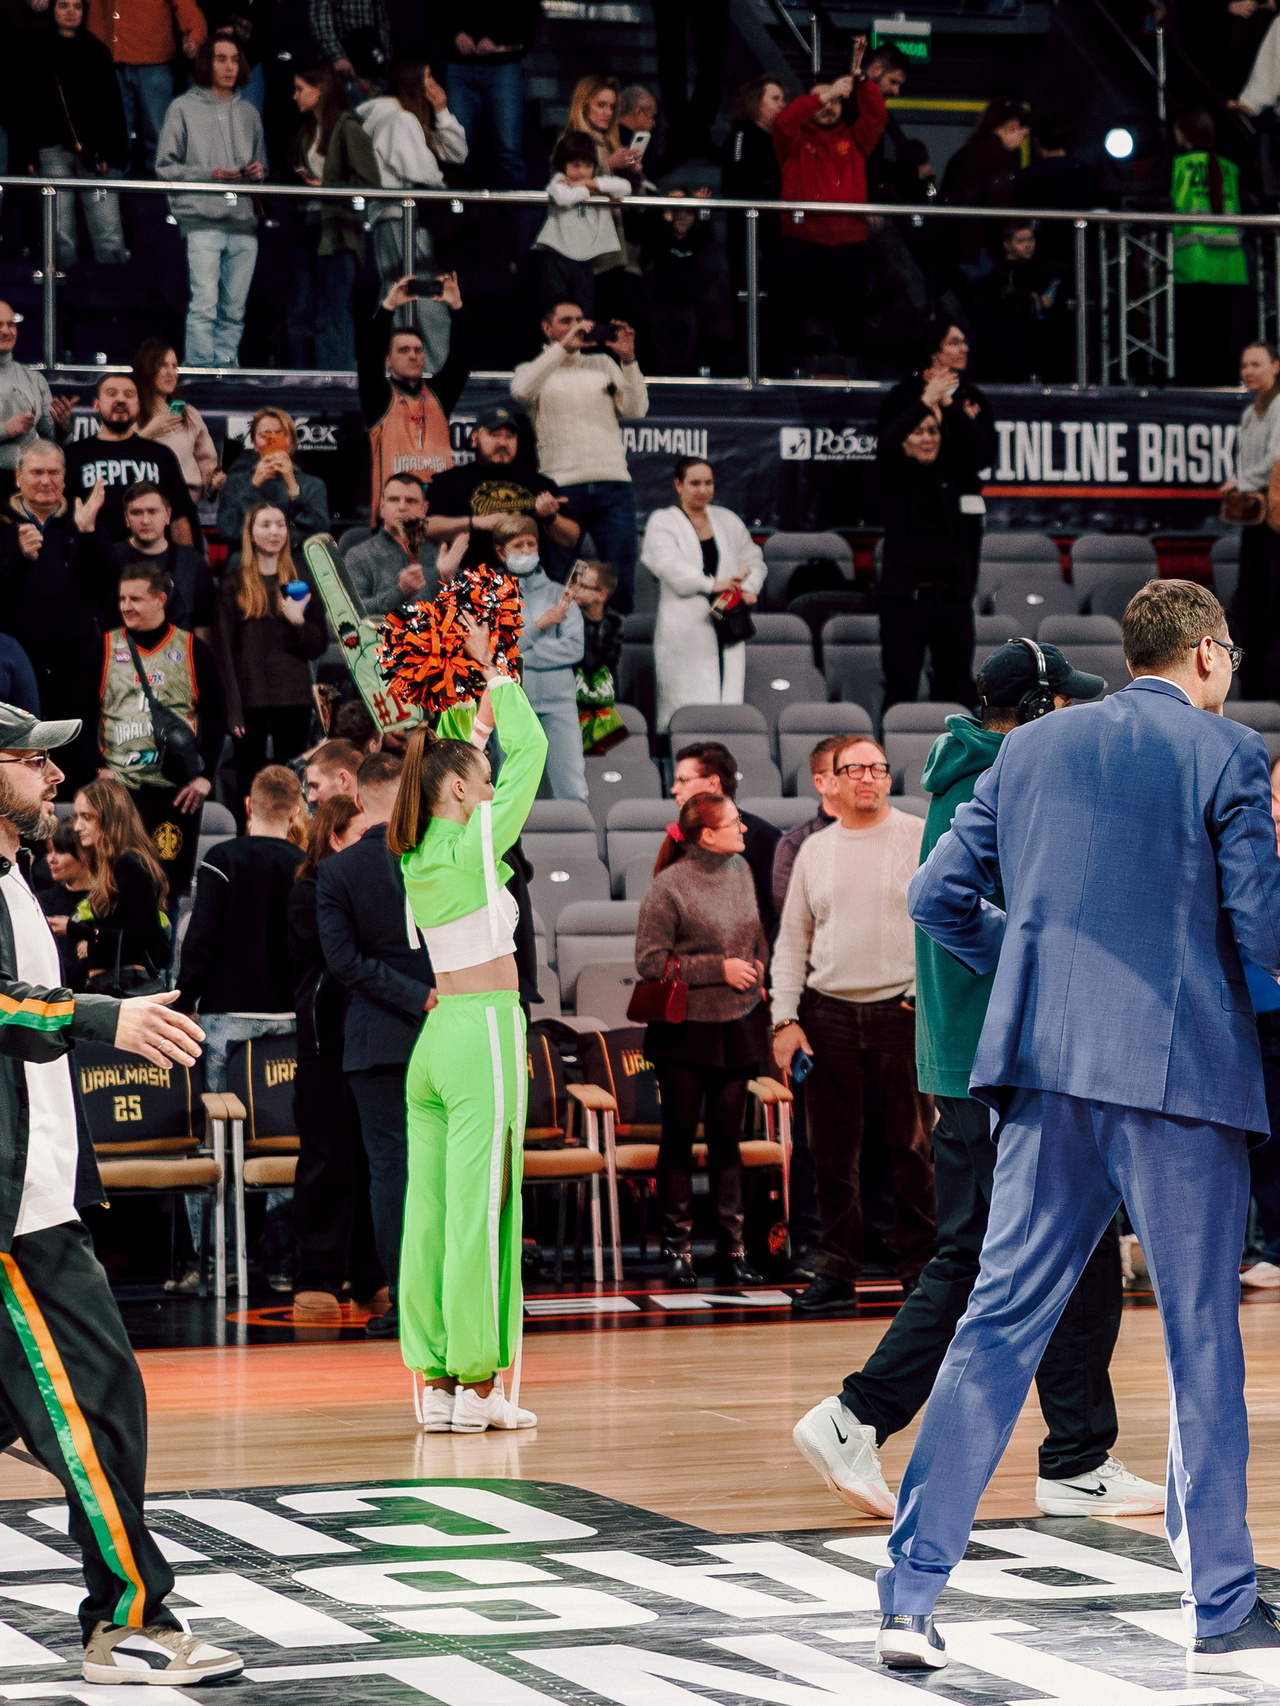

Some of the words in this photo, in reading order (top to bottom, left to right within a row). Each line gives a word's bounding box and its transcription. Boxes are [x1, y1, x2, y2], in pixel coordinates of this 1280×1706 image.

[620, 428, 708, 460] АЛМАШ
[979, 421, 1129, 481] INLINE
[1138, 424, 1240, 482] BASK
[81, 459, 160, 488] ВЕРГУН
[81, 1066, 171, 1094] URALMASH
[113, 1095, 143, 1122] 25
[0, 1486, 598, 1572] CU
[0, 1529, 1187, 1666] BASK
